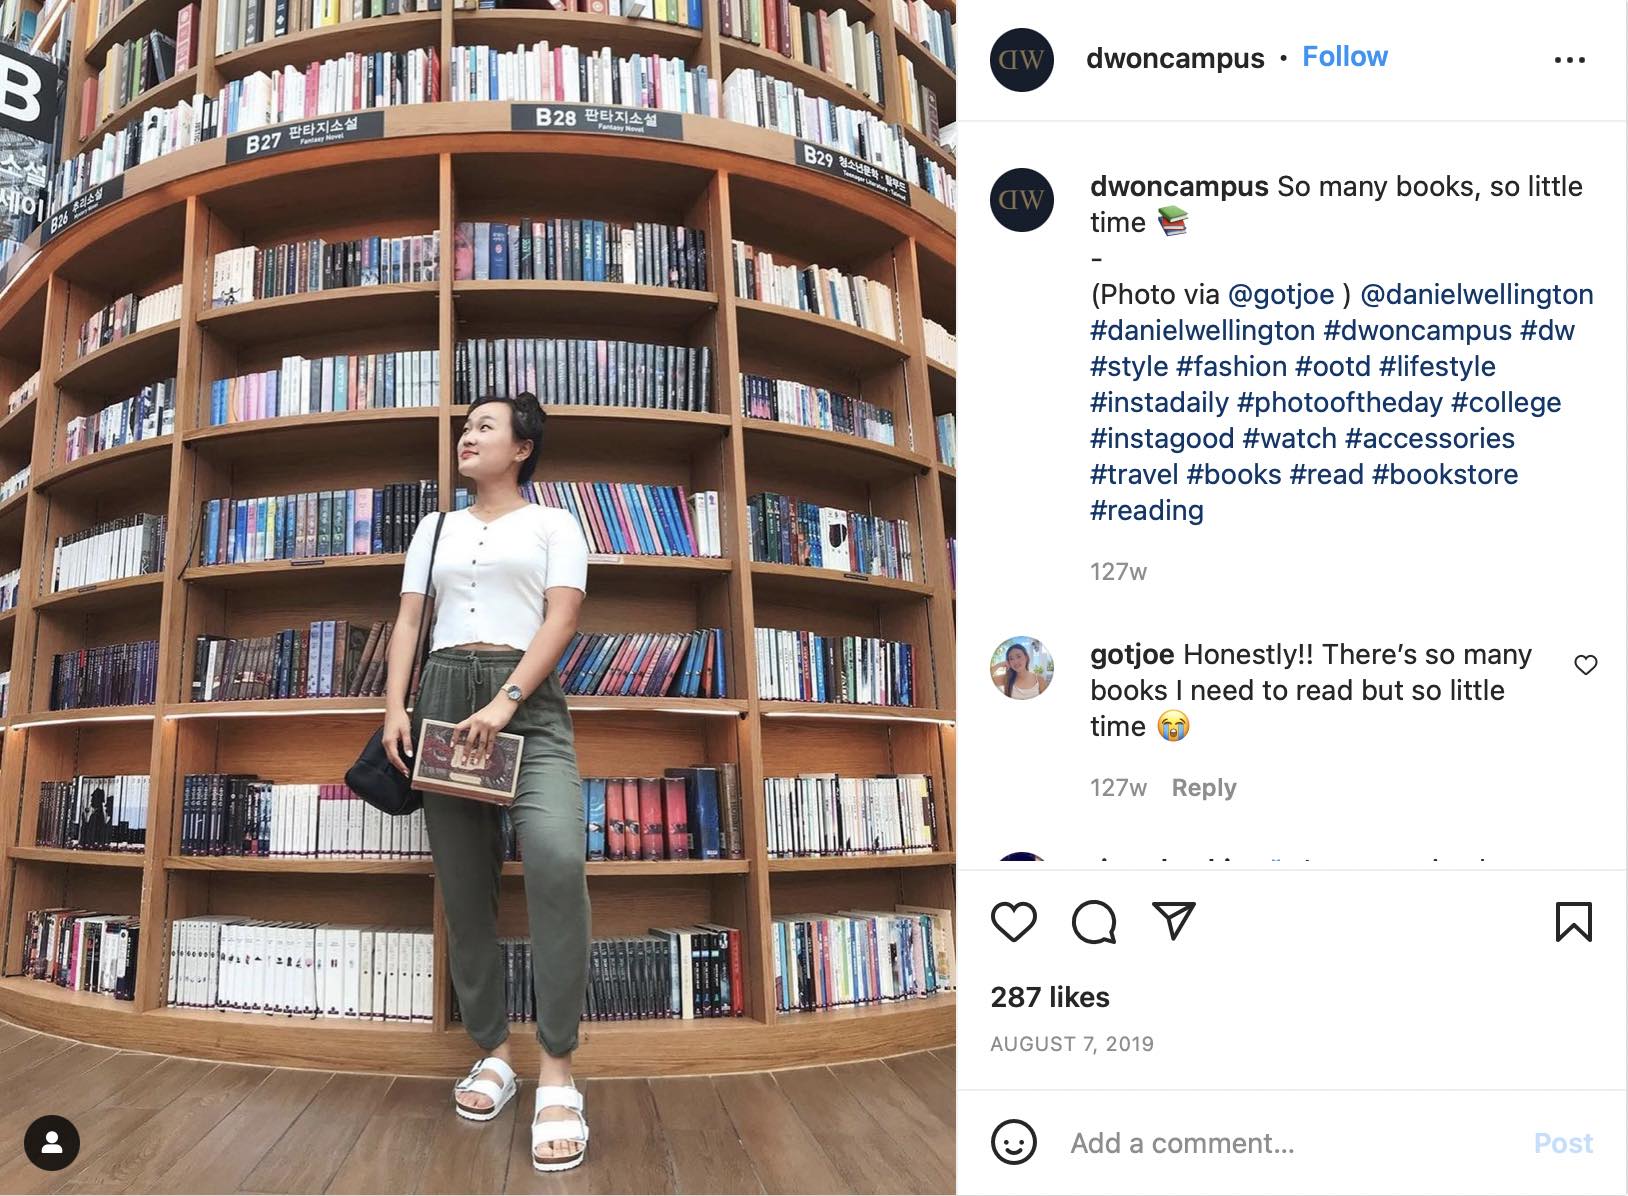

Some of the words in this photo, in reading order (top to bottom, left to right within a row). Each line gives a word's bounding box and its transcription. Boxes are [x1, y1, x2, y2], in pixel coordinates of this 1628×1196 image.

[0, 53, 42, 123] B
[288, 116, 358, 139] 판타지소설
[536, 107, 577, 126] B28
[584, 108, 657, 127] 판타지소설
[598, 123, 624, 132] Fantasy
[246, 132, 282, 155] B27
[300, 136, 325, 145] Fantasy
[325, 133, 344, 142] Novel
[803, 144, 833, 168] B29
[839, 155, 879, 180] 청소년문학
[51, 210, 68, 234] B26
